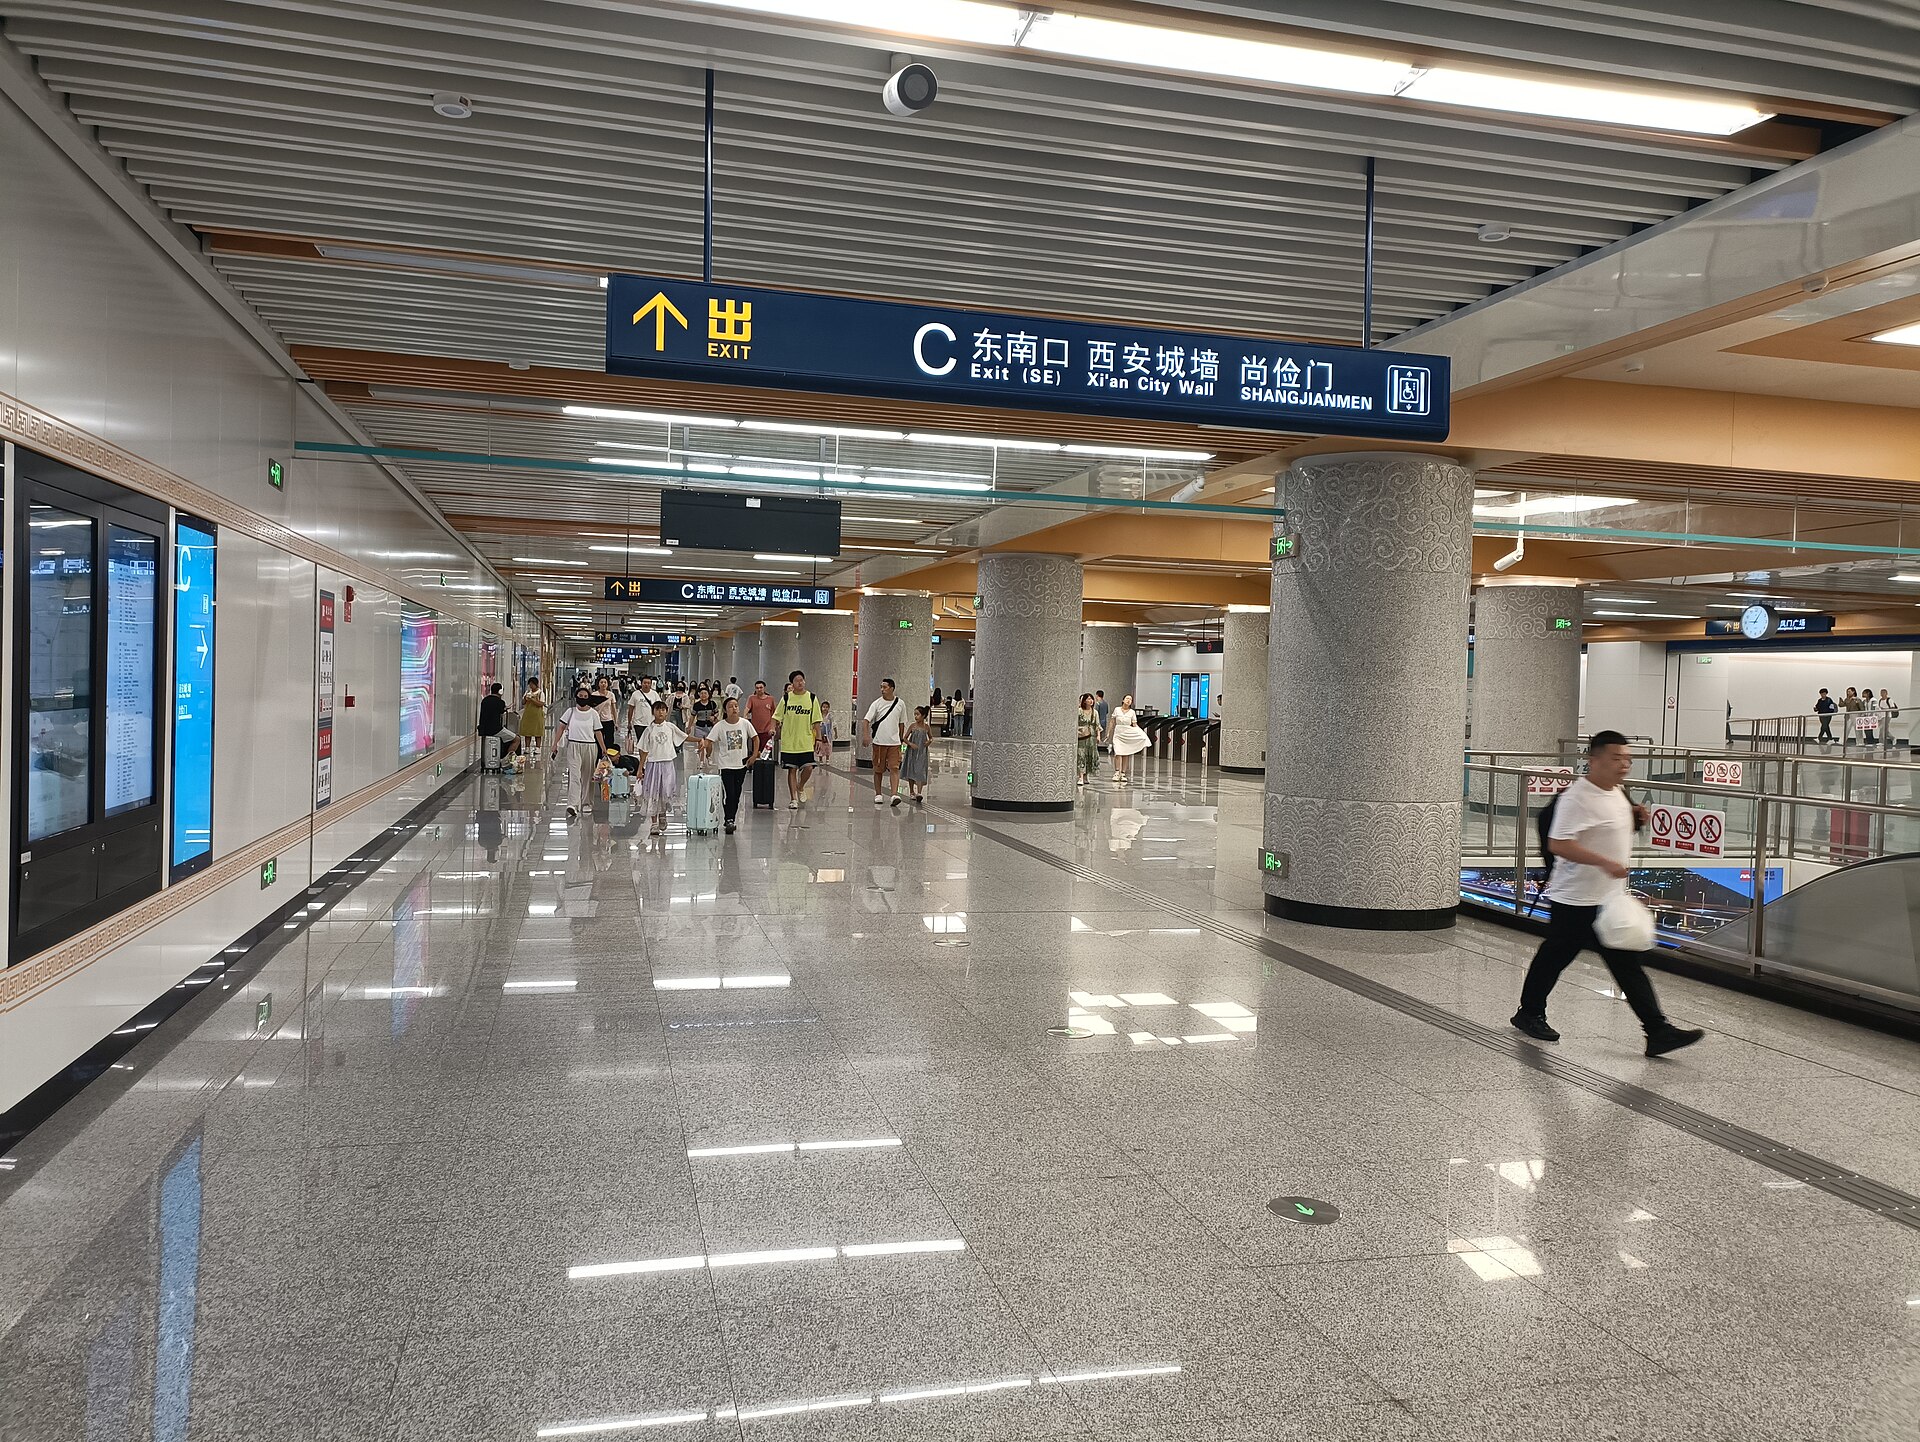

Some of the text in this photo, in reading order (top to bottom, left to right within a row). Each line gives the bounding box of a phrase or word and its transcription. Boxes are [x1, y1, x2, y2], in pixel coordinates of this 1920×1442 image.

[707, 298, 752, 342] 出
[707, 342, 752, 360] EXIT
[913, 322, 957, 376] C
[972, 327, 1333, 392] 东南口 西安城墙 尚俭门
[970, 362, 1373, 411] Exit (SE) Xi'an City Wall SHANGJIANMEN
[629, 581, 640, 592] 出
[681, 583, 694, 599] C
[697, 584, 725, 595] 东南口
[728, 586, 767, 597] 西安城墙
